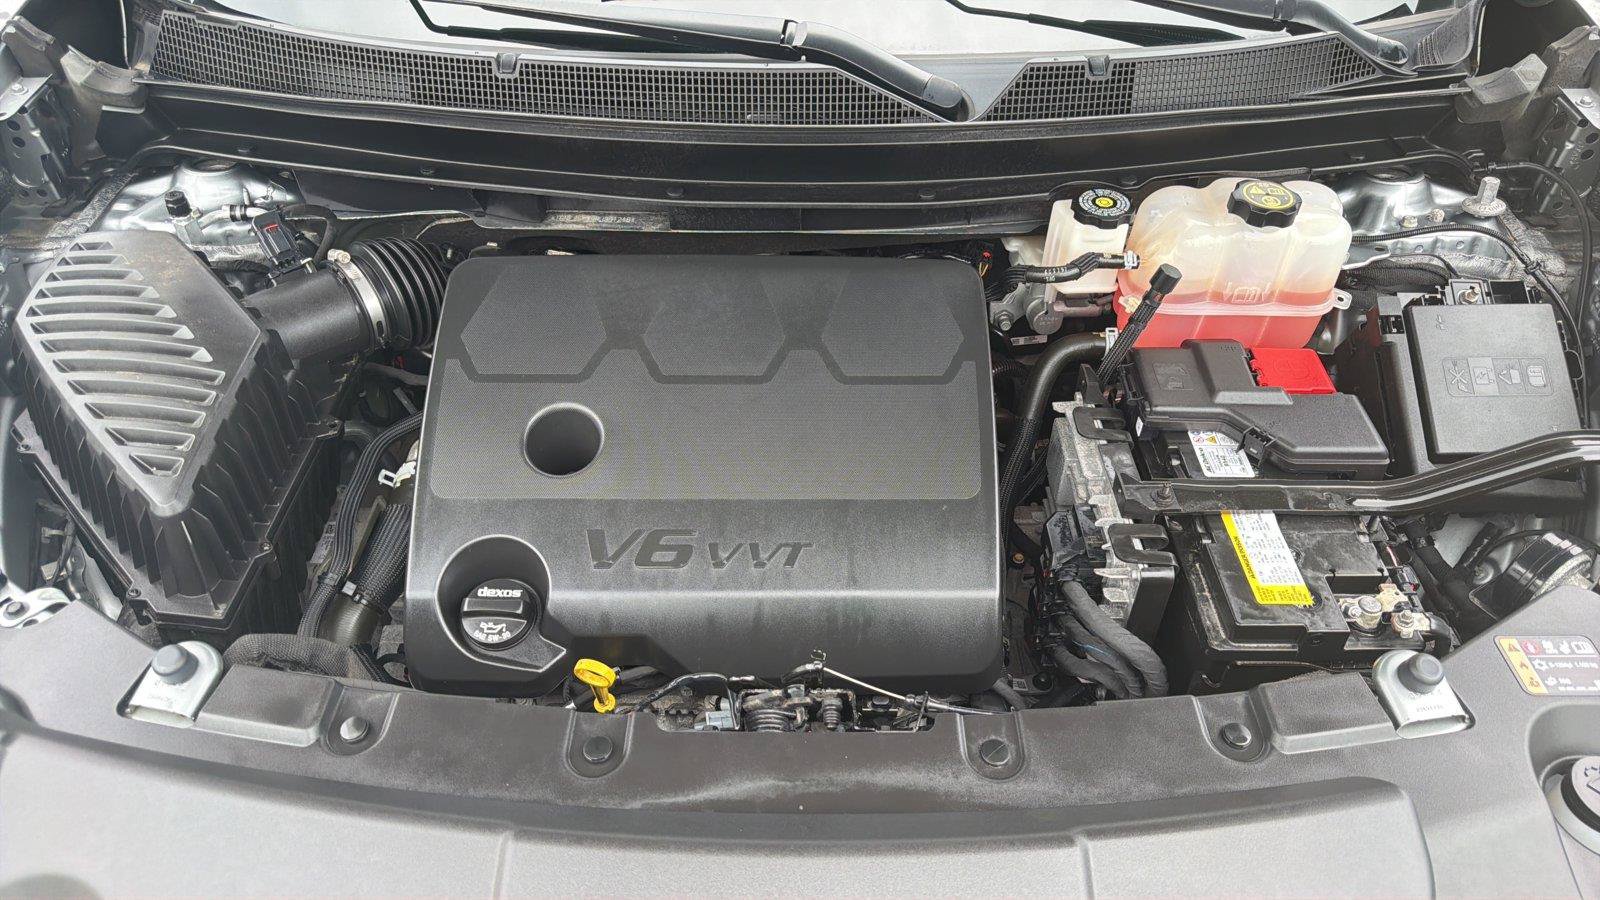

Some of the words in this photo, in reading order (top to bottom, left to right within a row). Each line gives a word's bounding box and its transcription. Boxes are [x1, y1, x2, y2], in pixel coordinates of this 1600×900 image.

[586, 528, 699, 570] V6
[708, 541, 814, 570] VVT
[477, 586, 523, 598] dexos
[473, 629, 487, 641] SAE
